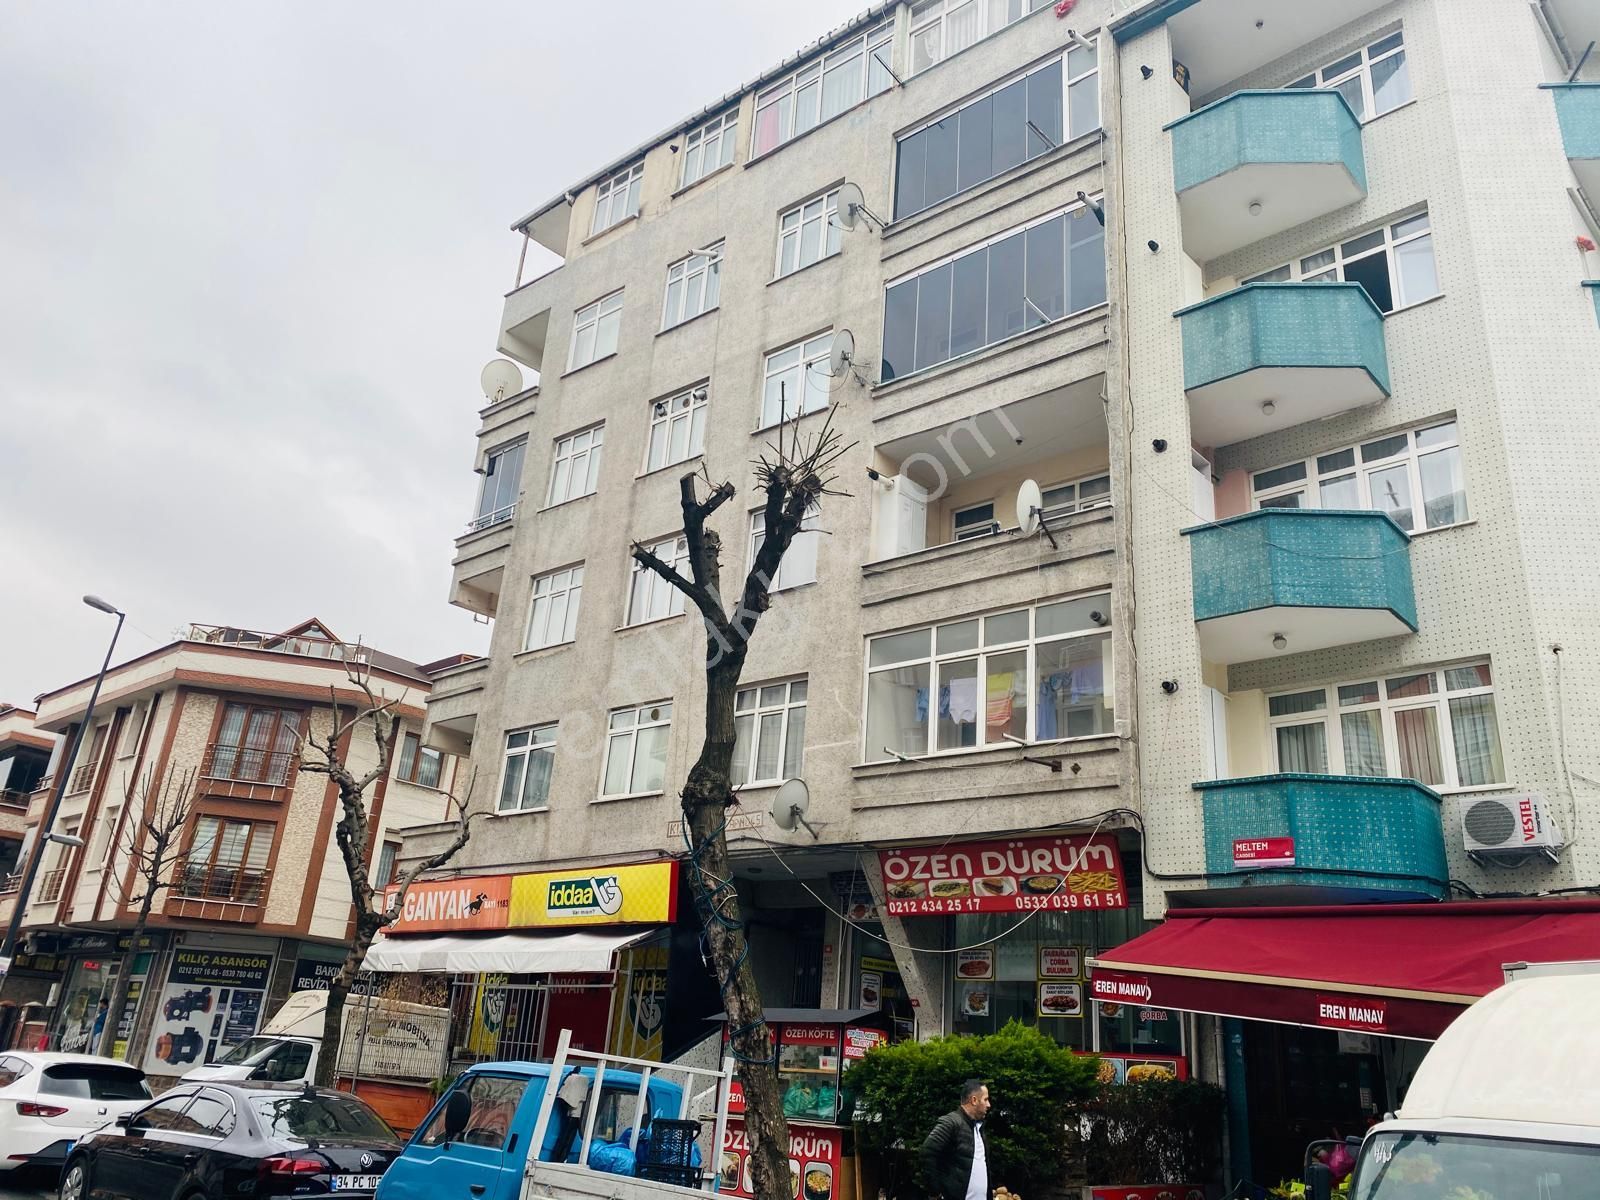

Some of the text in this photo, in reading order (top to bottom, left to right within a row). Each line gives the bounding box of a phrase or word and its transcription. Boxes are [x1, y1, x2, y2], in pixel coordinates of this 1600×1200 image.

[1519, 797, 1536, 843] VESTEL
[1235, 842, 1269, 852] MELTEM
[884, 838, 1114, 881] ÖZEN DÜRÜM
[550, 880, 593, 907] iddaa
[404, 888, 472, 922] GANYAN
[889, 892, 1123, 913] 0212 434 25 17 0533 039 61 51
[178, 953, 268, 969] KILIÇ ASANSÖR
[204, 967, 211, 976] 16
[298, 976, 330, 990] REVİZY
[1095, 980, 1146, 997] EREN MANAV
[1141, 1011, 1168, 1022] ÇORBA
[1320, 1003, 1384, 1024] EREN MANAV
[785, 1026, 807, 1039] ÖZEN
[808, 1027, 836, 1040] KÖFTE
[728, 1092, 742, 1104] ZEN
[722, 1122, 833, 1160] ÖZE RÜM
[337, 1176, 349, 1188] 34
[352, 1176, 364, 1188] PC
